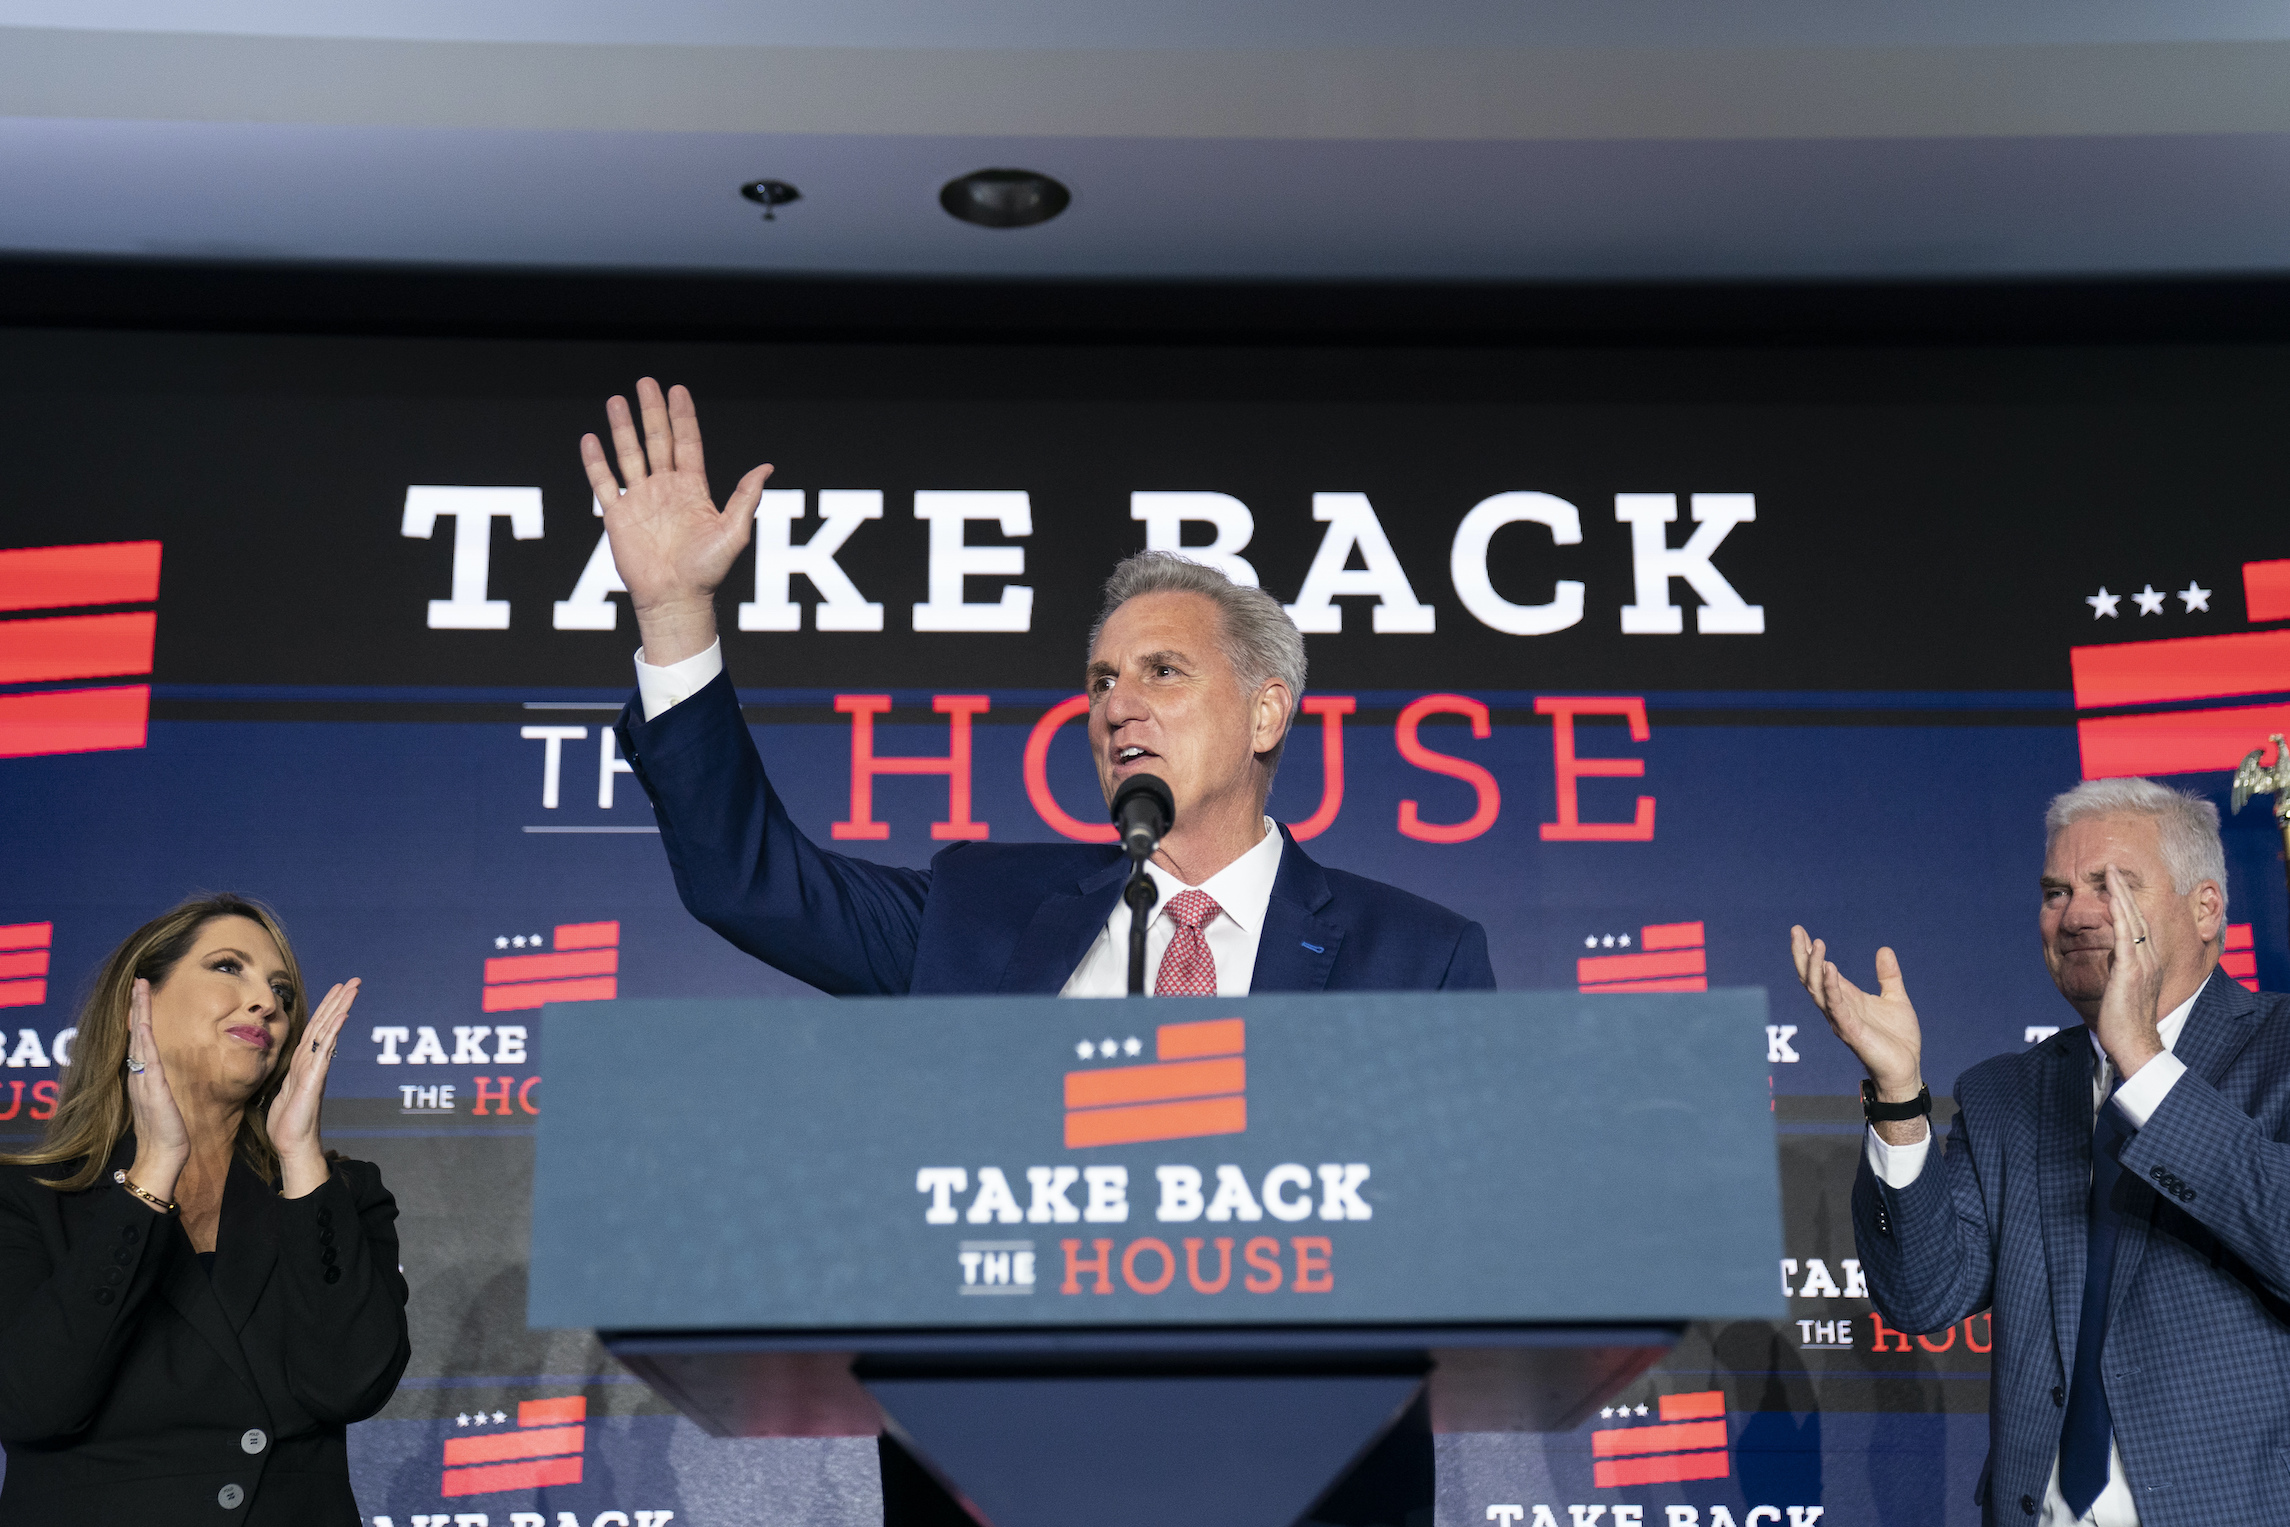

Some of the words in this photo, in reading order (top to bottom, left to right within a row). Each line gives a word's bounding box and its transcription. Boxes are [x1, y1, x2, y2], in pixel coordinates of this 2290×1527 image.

[1130, 490, 1766, 636] BACK
[520, 725, 655, 810] TH
[371, 1025, 529, 1065] TAKE
[398, 1084, 457, 1109] THE
[915, 1166, 1131, 1225] TAKE
[1155, 1163, 1374, 1222] BACK
[959, 1250, 1037, 1287] THE
[1059, 1235, 1336, 1296] HOUSE
[1795, 1319, 1855, 1344] THE
